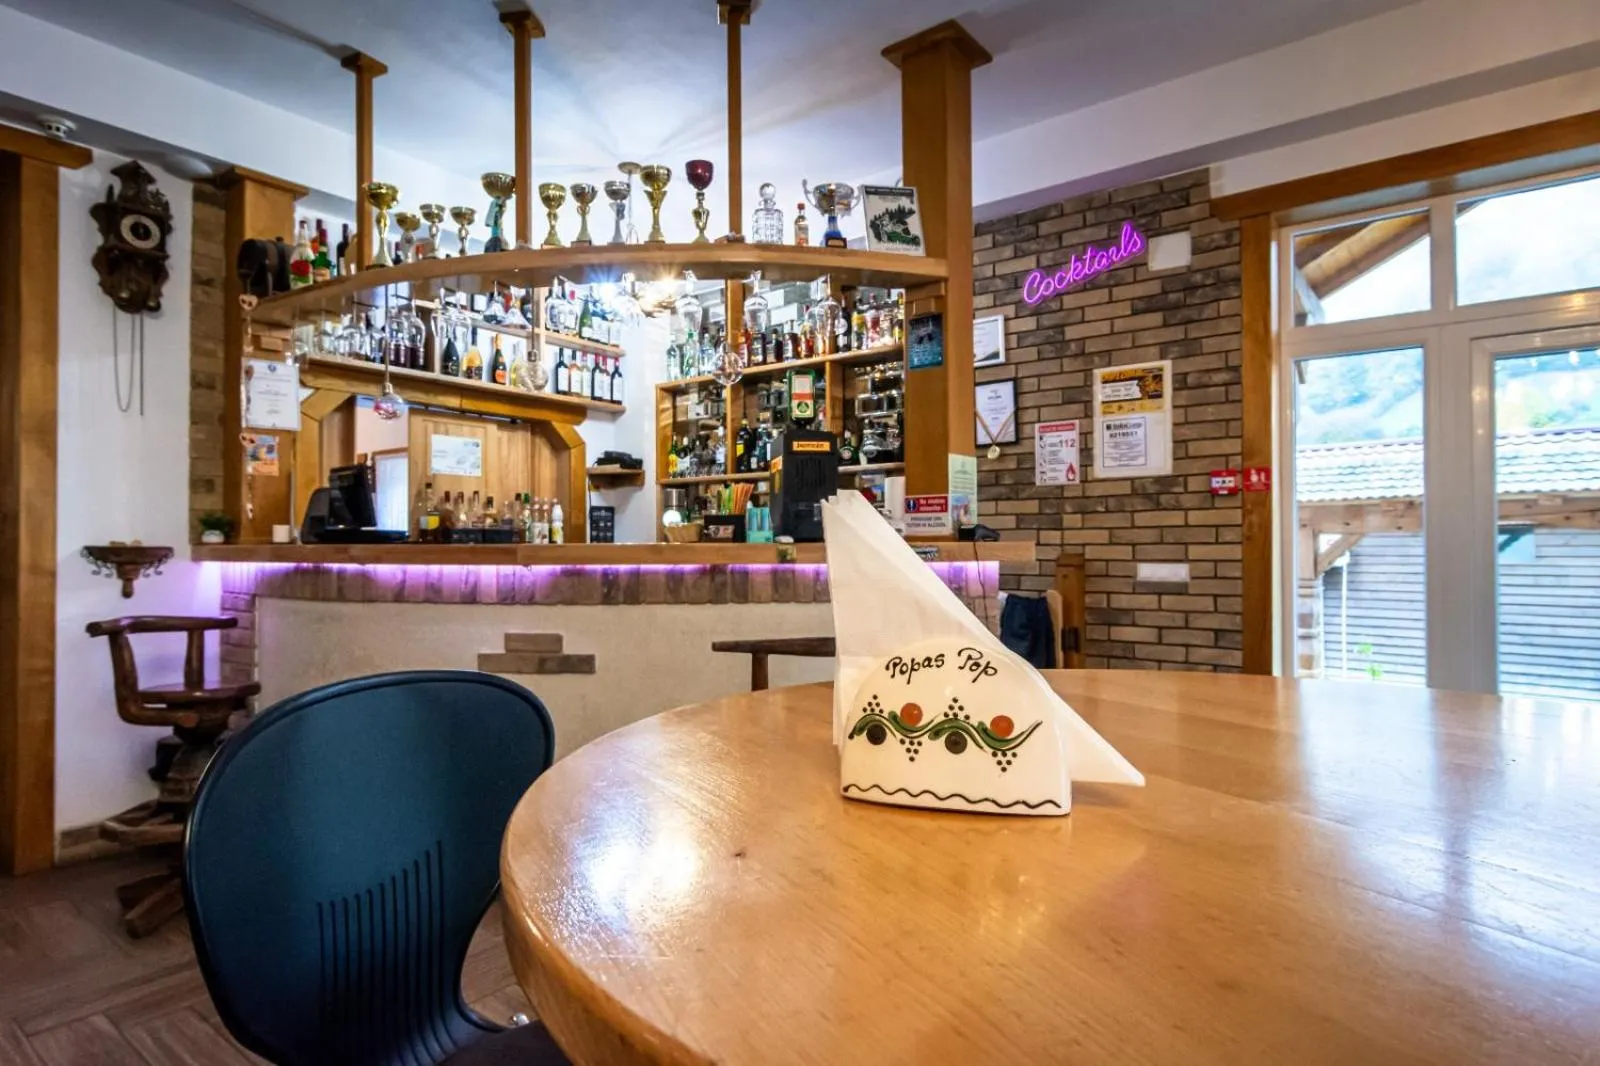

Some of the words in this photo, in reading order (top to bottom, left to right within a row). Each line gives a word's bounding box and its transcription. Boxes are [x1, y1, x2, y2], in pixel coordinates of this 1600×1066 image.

[1023, 222, 1142, 303] Cocktails
[1059, 438, 1076, 448] 112
[885, 653, 945, 685] Popas
[957, 647, 998, 683] Pop
